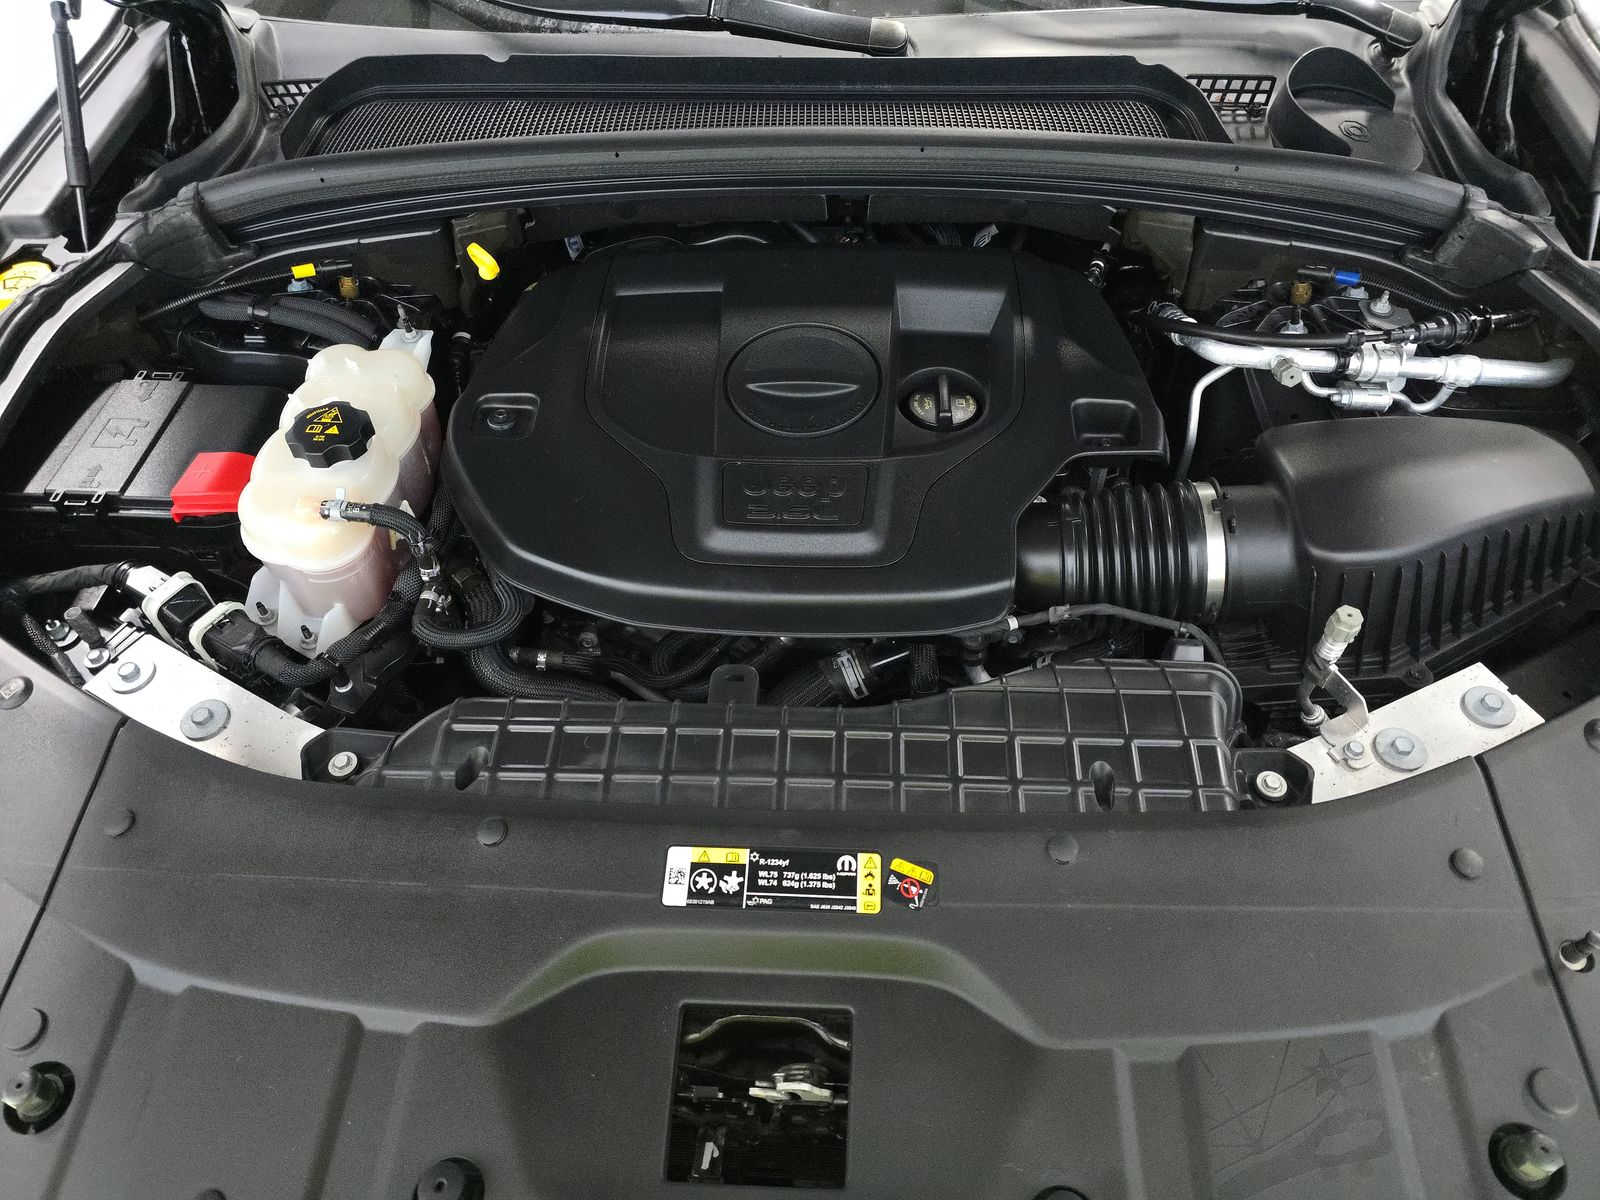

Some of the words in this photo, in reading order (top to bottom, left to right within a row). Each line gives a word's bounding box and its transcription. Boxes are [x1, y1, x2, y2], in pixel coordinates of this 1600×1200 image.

[743, 471, 847, 503] Jeep
[759, 858, 790, 868] R-1234yf
[758, 870, 779, 879] WL75
[782, 871, 800, 881] 737g
[800, 872, 822, 881] (1.625
[822, 872, 836, 882] lbs)
[757, 878, 778, 887] WL74
[782, 879, 800, 889] 624g
[800, 880, 822, 889] (1.375
[822, 881, 836, 890] lbs)
[759, 897, 773, 905] PAG
